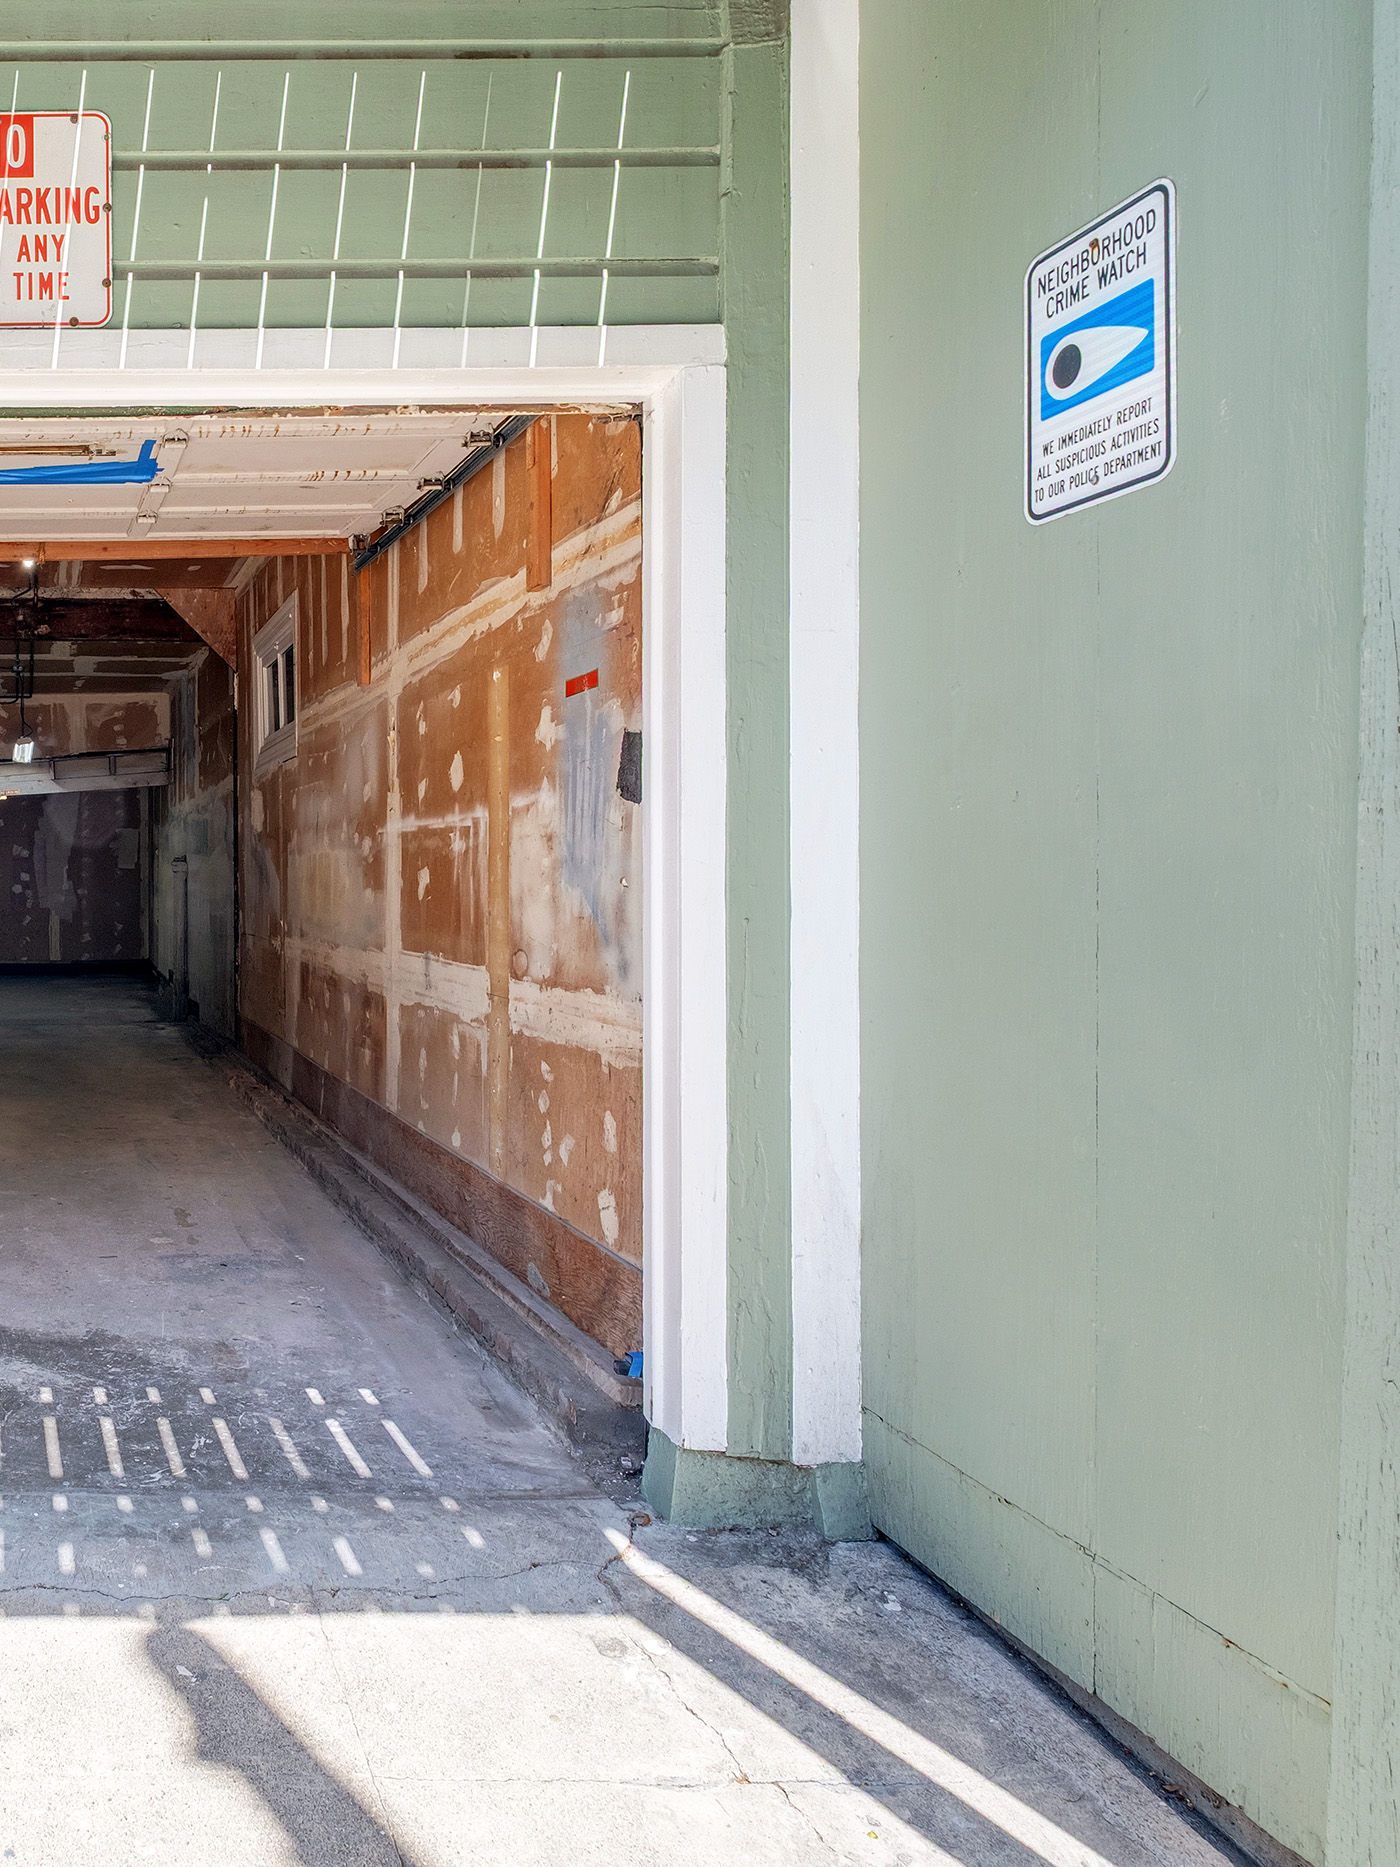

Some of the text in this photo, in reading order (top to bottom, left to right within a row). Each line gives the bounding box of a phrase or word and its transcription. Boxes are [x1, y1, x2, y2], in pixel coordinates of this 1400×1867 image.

[16, 234, 66, 263] ANY
[1037, 208, 1156, 298] NEIGHBORHOOD
[1046, 241, 1147, 319] CRIME WATCH
[12, 272, 70, 301] TIME
[1036, 418, 1160, 481] ALL SUSPICIOUS ACTIVITIES
[1042, 397, 1153, 458] WE IMMEDIATELY REPORT
[1034, 487, 1044, 503] TO
[1048, 479, 1065, 498] OUR
[1103, 440, 1162, 477] DEPARTMENT
